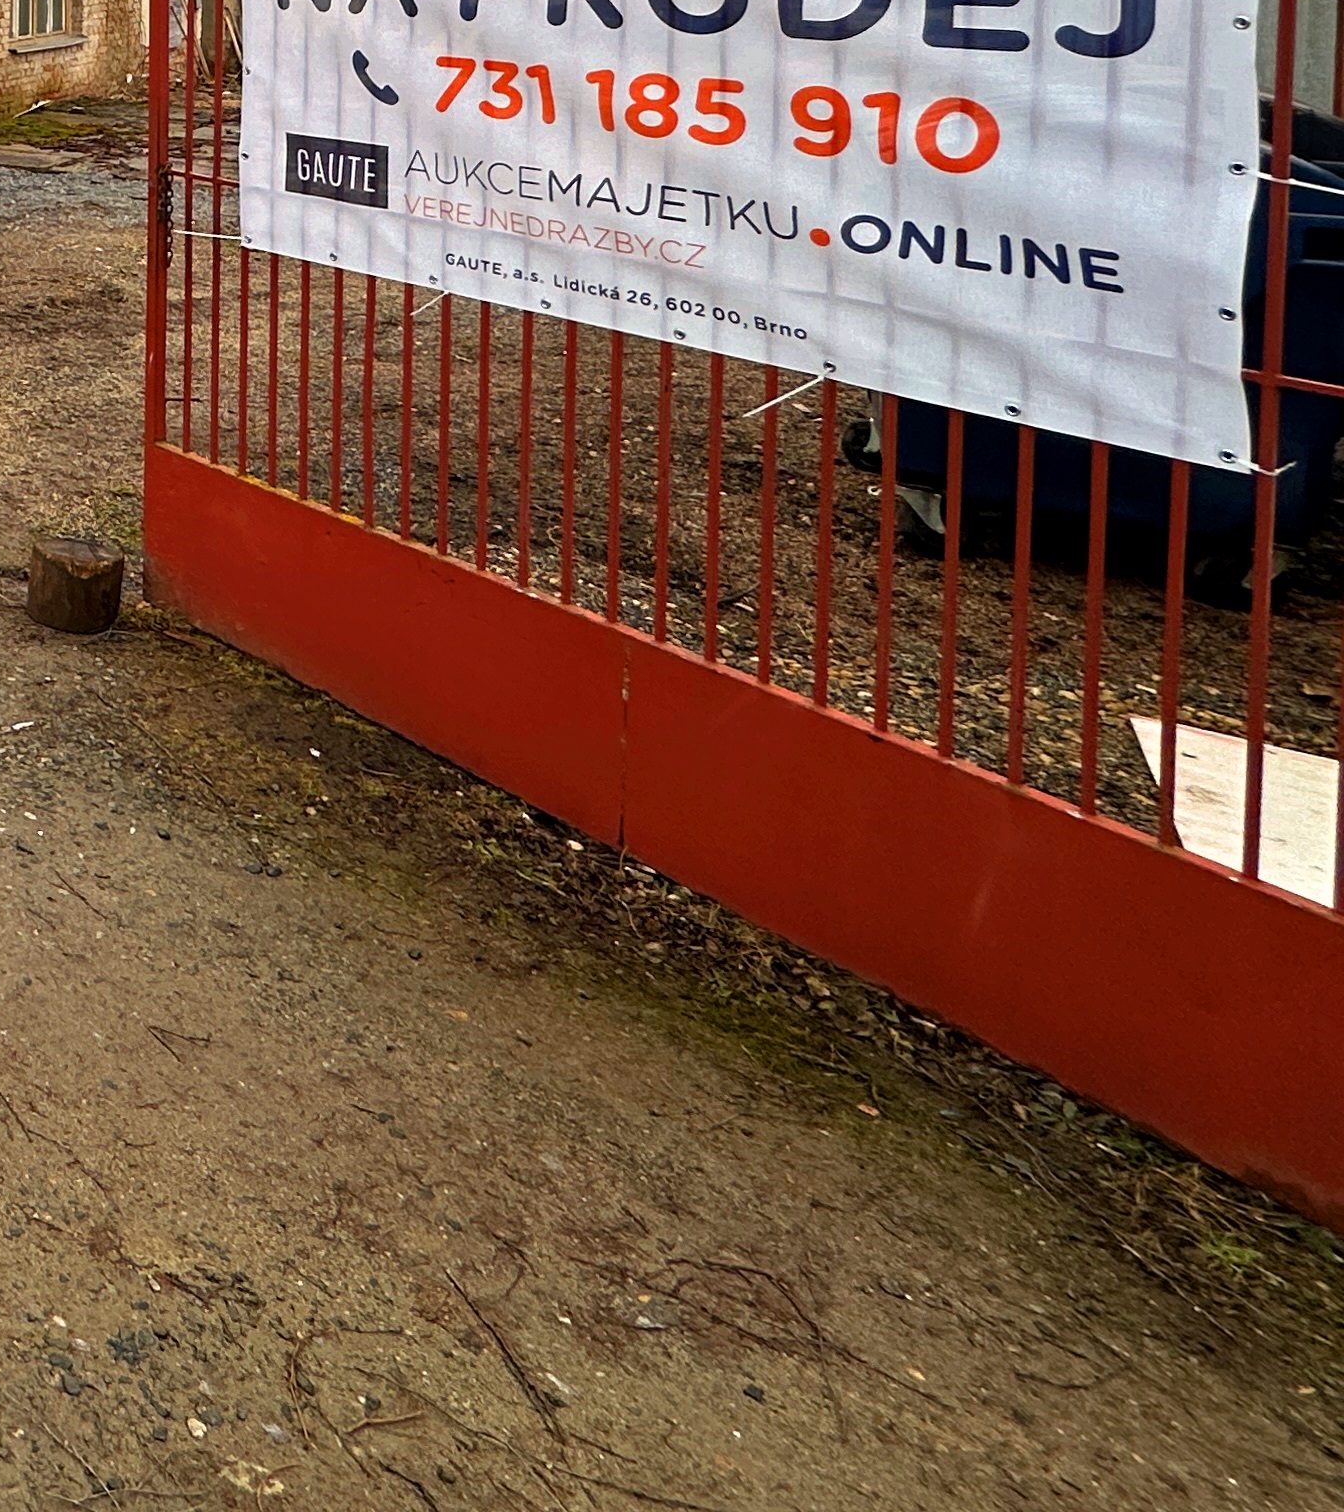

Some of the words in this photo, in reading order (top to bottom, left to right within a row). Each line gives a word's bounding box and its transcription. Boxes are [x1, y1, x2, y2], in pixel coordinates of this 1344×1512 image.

[435, 55, 556, 124] 731
[585, 68, 748, 147] 185
[789, 85, 1001, 174] 910
[295, 147, 377, 194] GAUTE
[403, 193, 707, 270] VEREJNEDRAZBY.CZ
[404, 148, 1125, 294] AUKCEMAJETKU.ONLINE
[444, 252, 508, 280] GAUTE,
[512, 266, 544, 284] a.s.
[553, 272, 621, 301] Lidická
[626, 286, 659, 312] 26,
[664, 294, 707, 318] 602
[711, 304, 749, 330] 00,
[754, 314, 808, 341] Brno
